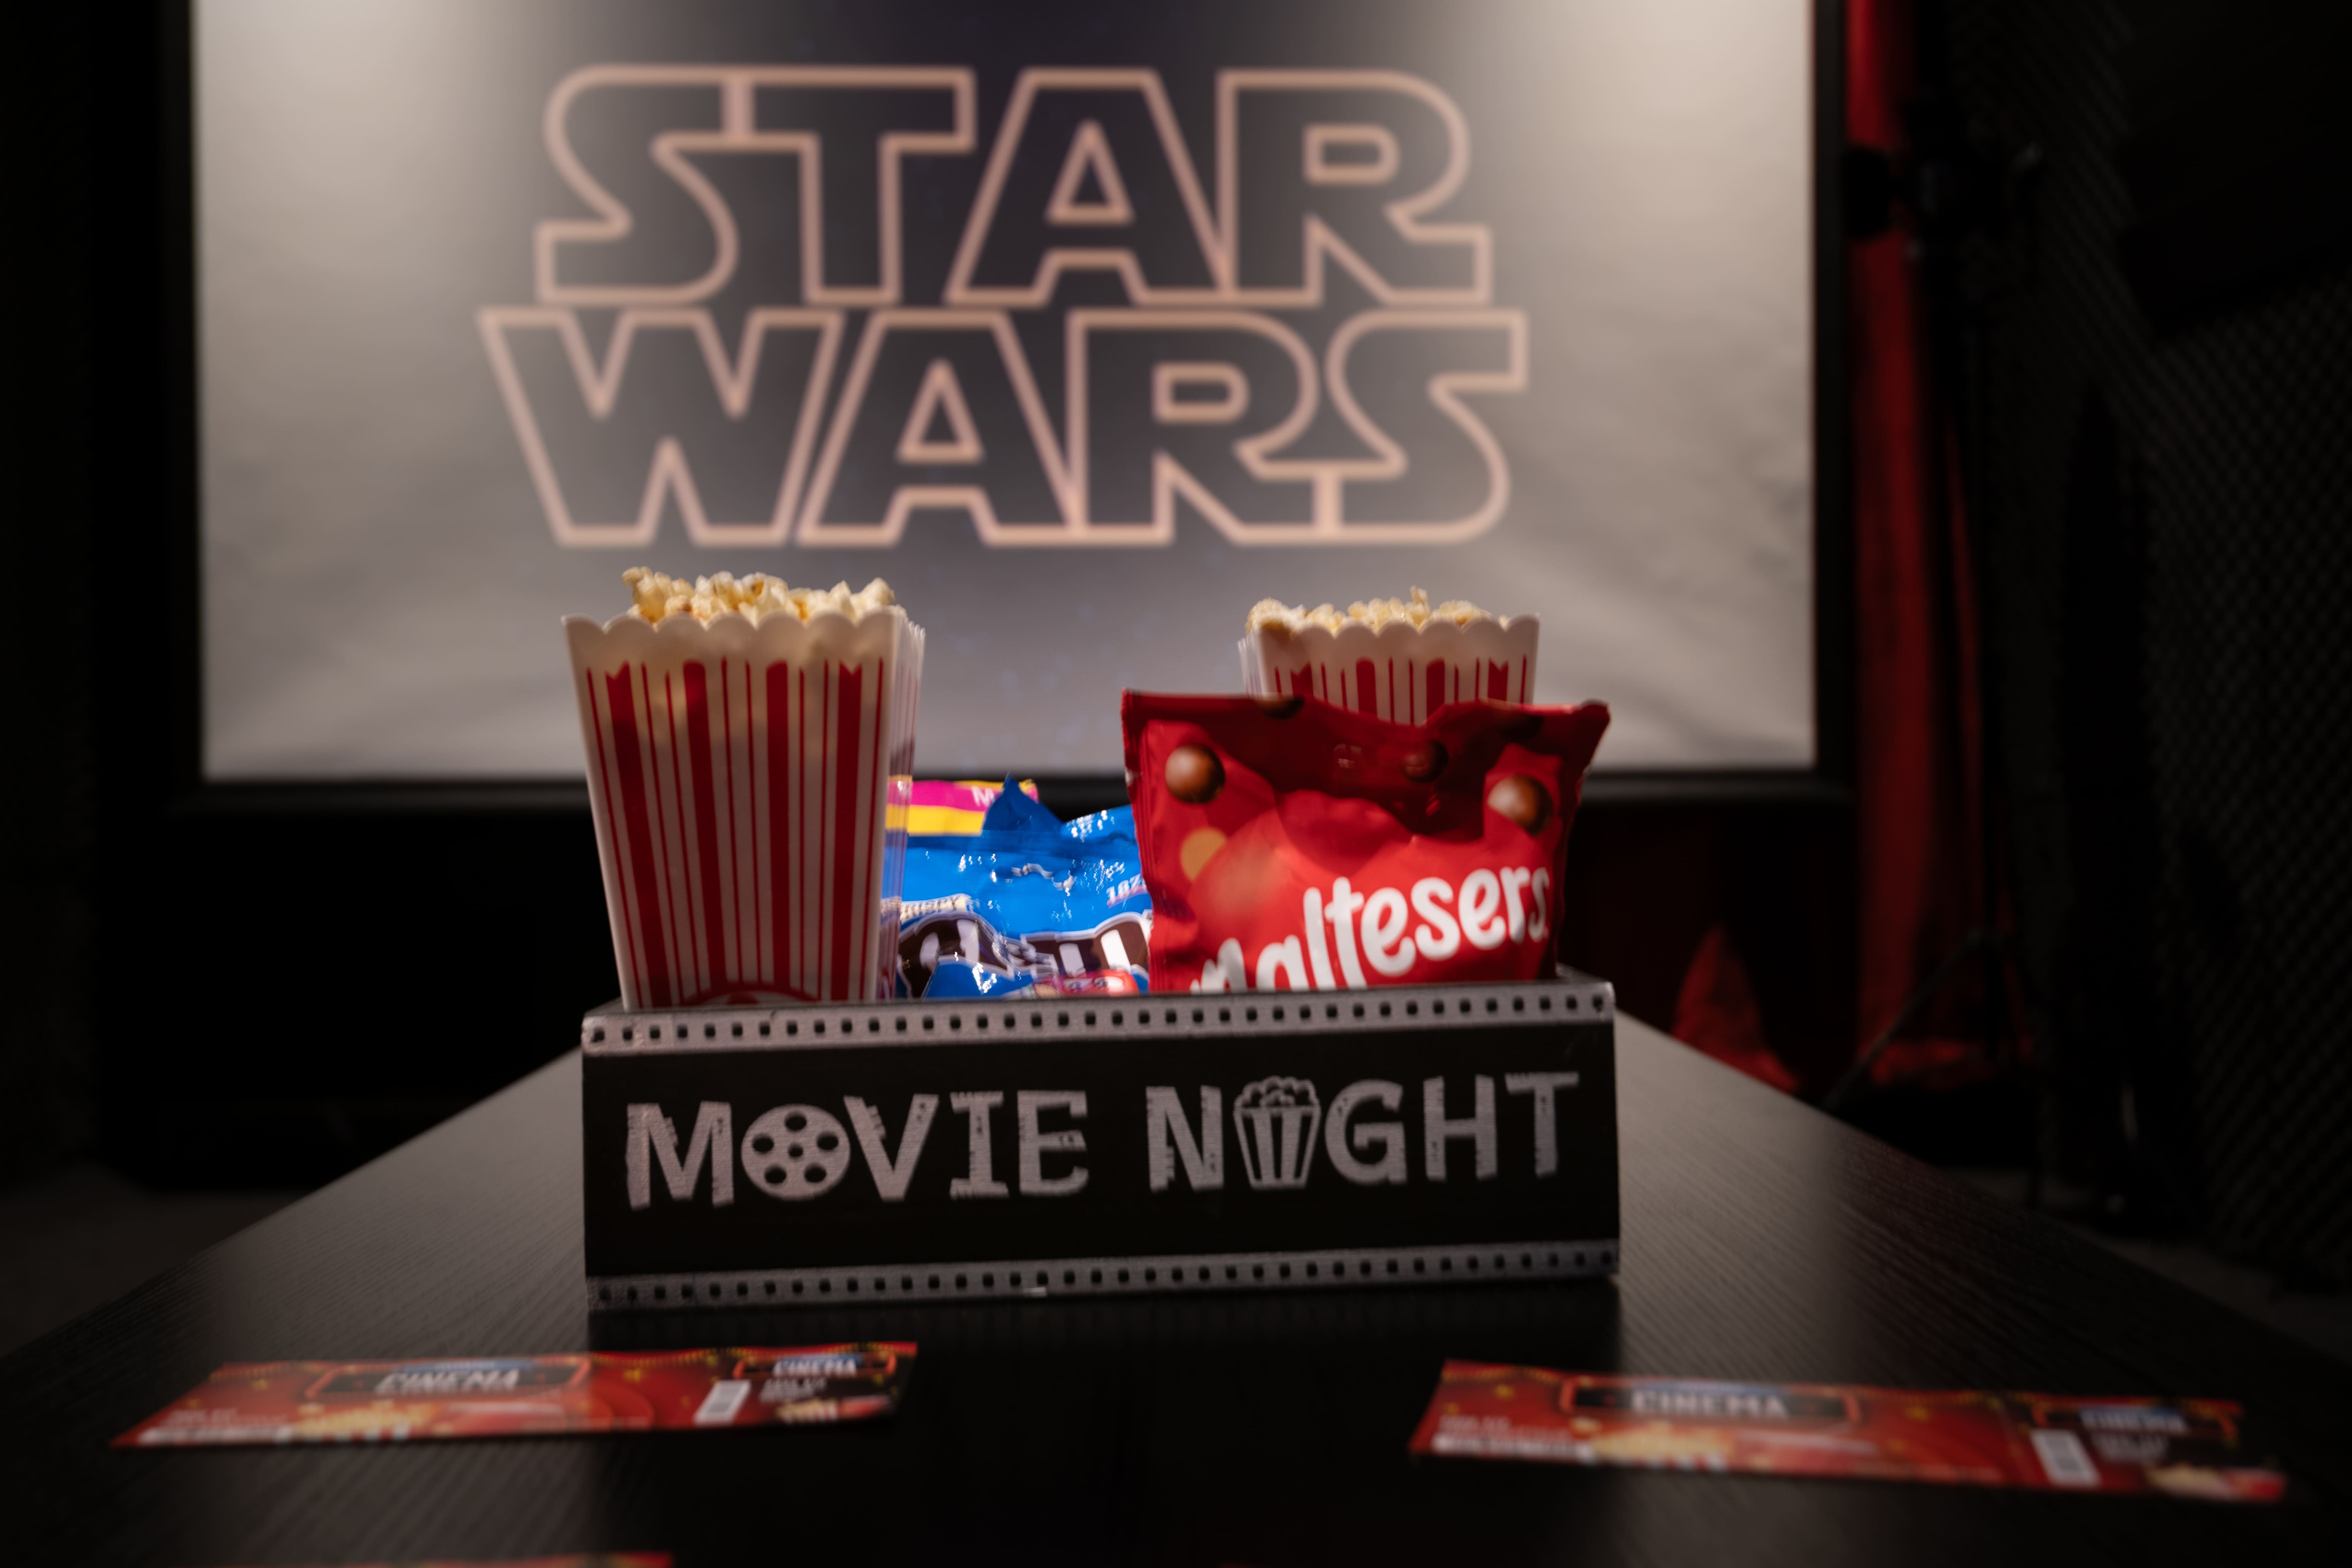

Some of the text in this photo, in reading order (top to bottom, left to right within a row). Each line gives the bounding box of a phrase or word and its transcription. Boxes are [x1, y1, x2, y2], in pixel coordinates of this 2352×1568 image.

[535, 66, 1492, 305] STAR
[477, 308, 1527, 546] WARS
[1106, 873, 1148, 905] 187
[892, 895, 959, 920] RISPY
[625, 1089, 1089, 1210] MOVIE
[374, 1368, 520, 1395] CINEMA
[1631, 1390, 1790, 1419] CINEMA
